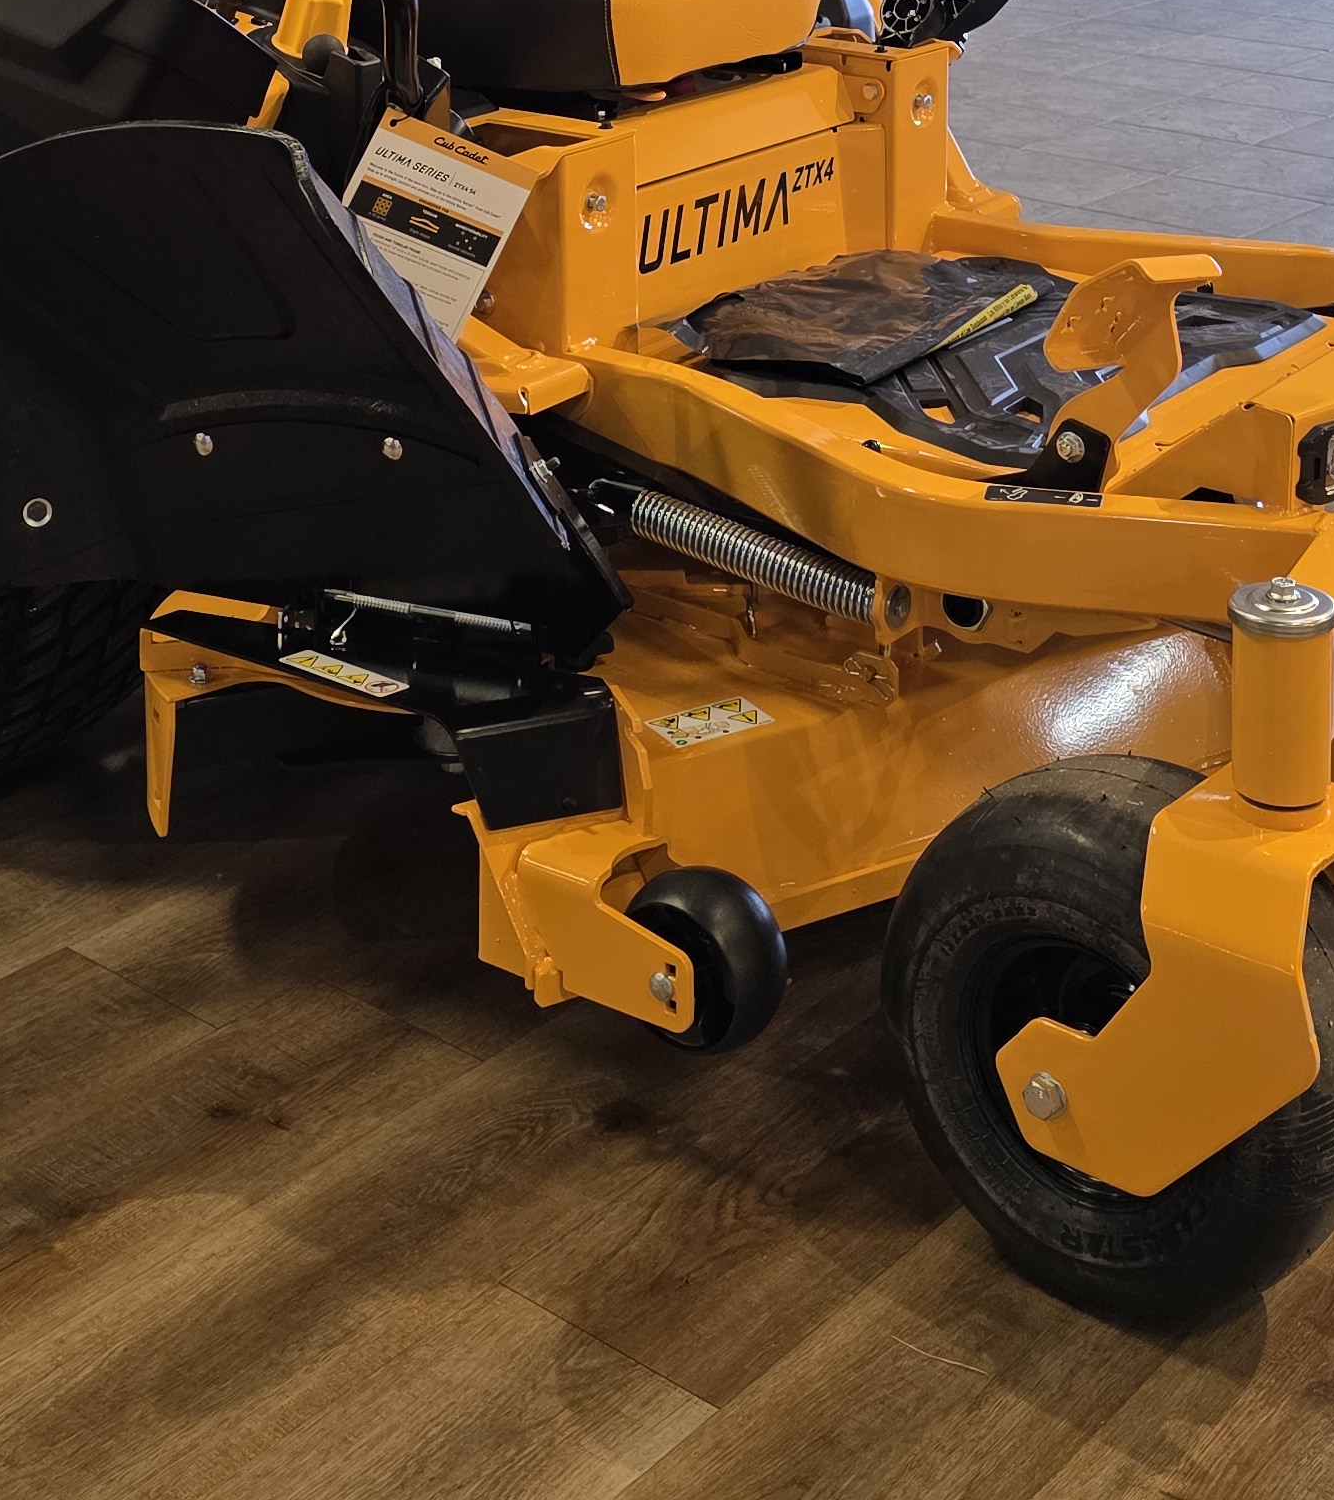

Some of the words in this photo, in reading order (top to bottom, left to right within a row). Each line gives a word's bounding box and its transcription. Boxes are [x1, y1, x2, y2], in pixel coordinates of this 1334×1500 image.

[375, 146, 412, 167] ULTIMA
[412, 162, 450, 183] SERIES
[434, 136, 454, 150] Cub
[455, 145, 489, 165] Cadet
[639, 171, 789, 275] ULTIMA
[792, 157, 834, 192] ZTX4
